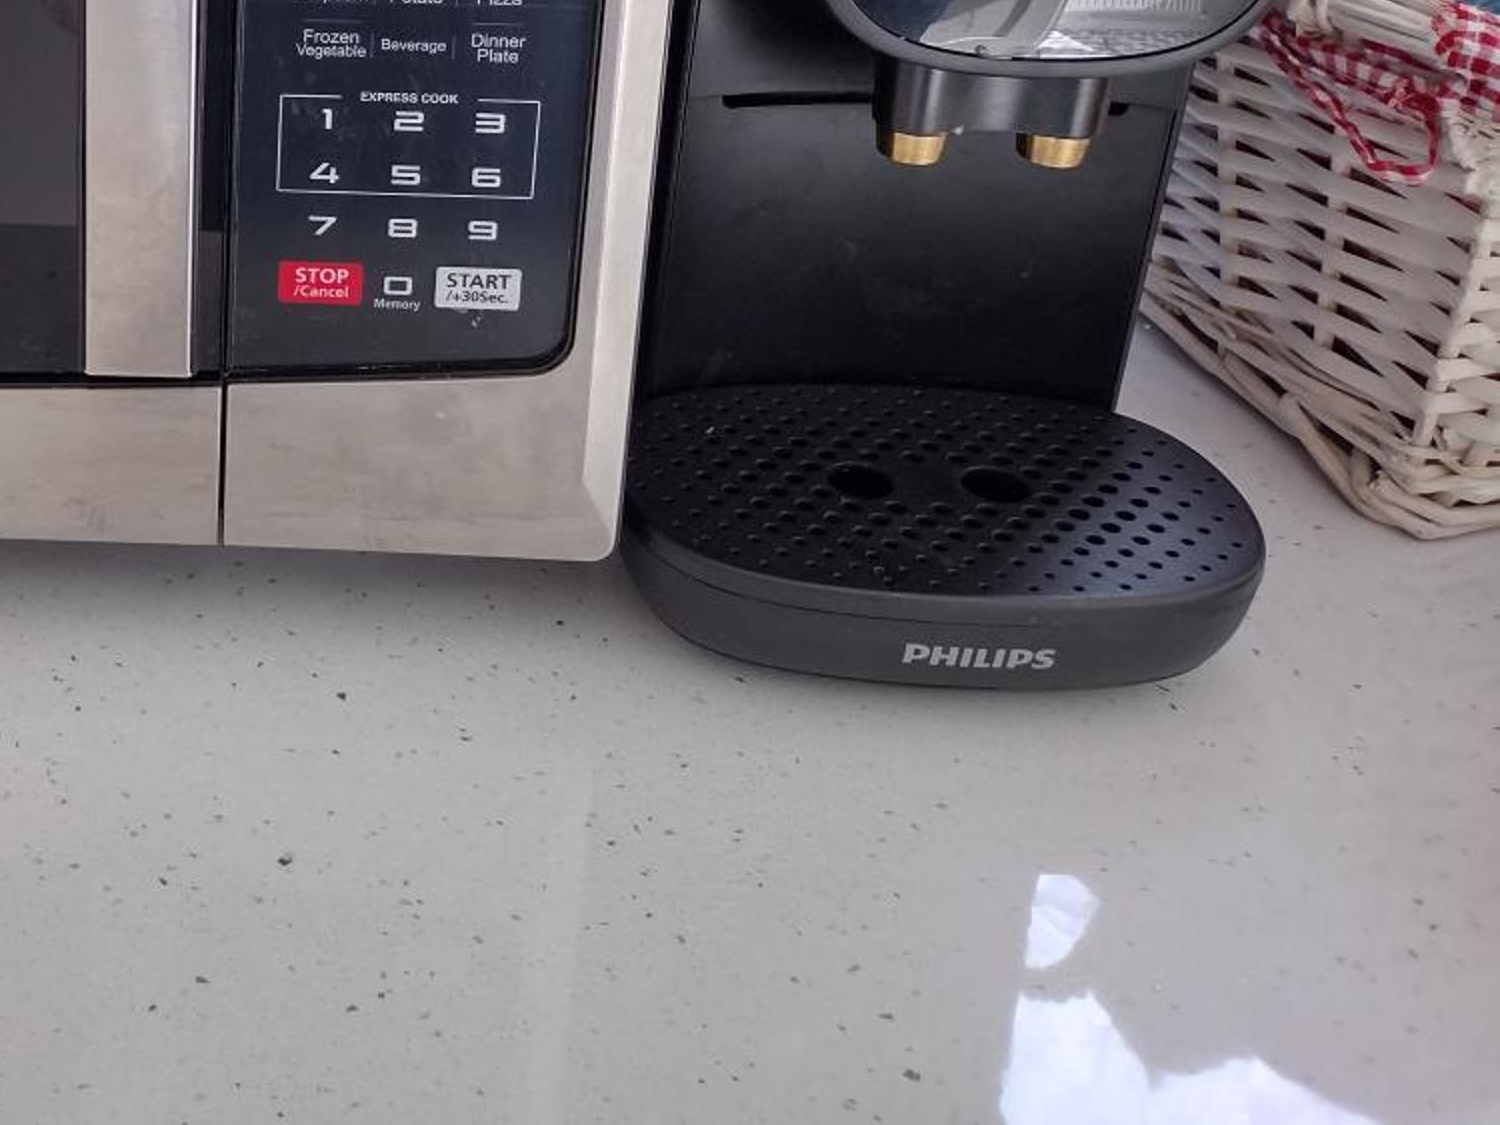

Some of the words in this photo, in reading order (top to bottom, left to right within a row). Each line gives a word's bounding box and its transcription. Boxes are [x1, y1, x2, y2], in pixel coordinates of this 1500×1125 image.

[303, 29, 360, 45] Frozen
[380, 38, 447, 55] Beverage
[471, 34, 526, 49] Dinner
[296, 43, 367, 60] Vegetable
[476, 48, 519, 64] Plate
[360, 91, 418, 105] EXPRESS
[420, 92, 459, 105] COOK
[321, 108, 333, 131] 1
[393, 110, 425, 132] 2
[475, 112, 506, 134] 3
[309, 162, 340, 185] 4
[390, 165, 421, 186] 5
[471, 167, 501, 189] 6
[308, 215, 338, 236] 7
[387, 218, 418, 239] 8
[468, 221, 498, 241] 9
[294, 266, 349, 283] STOP
[447, 273, 512, 290] START
[373, 298, 421, 312] Memory
[901, 642, 1057, 670] PHILIPS
